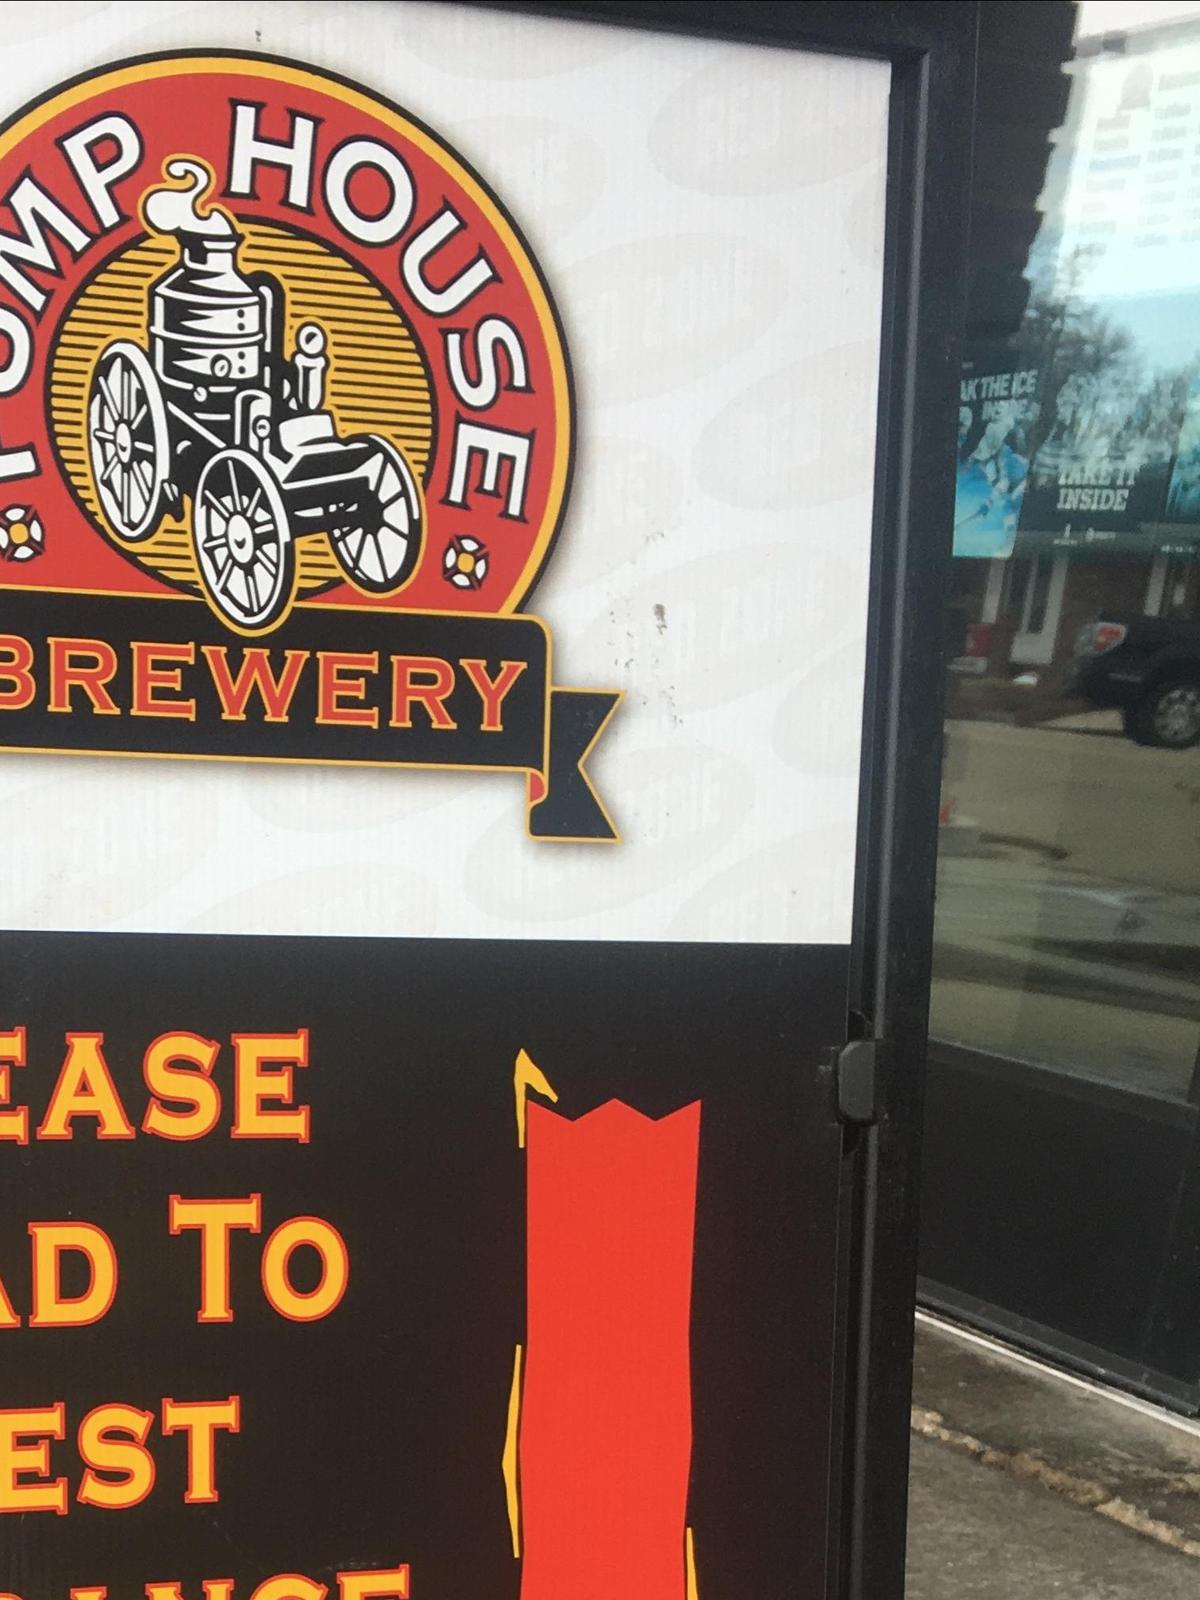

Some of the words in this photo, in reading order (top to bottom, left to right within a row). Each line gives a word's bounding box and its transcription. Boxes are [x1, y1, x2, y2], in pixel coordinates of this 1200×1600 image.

[227, 99, 536, 525] HOUSE
[1056, 488, 1129, 511] INSIDE
[169, 1193, 350, 1323] TO
